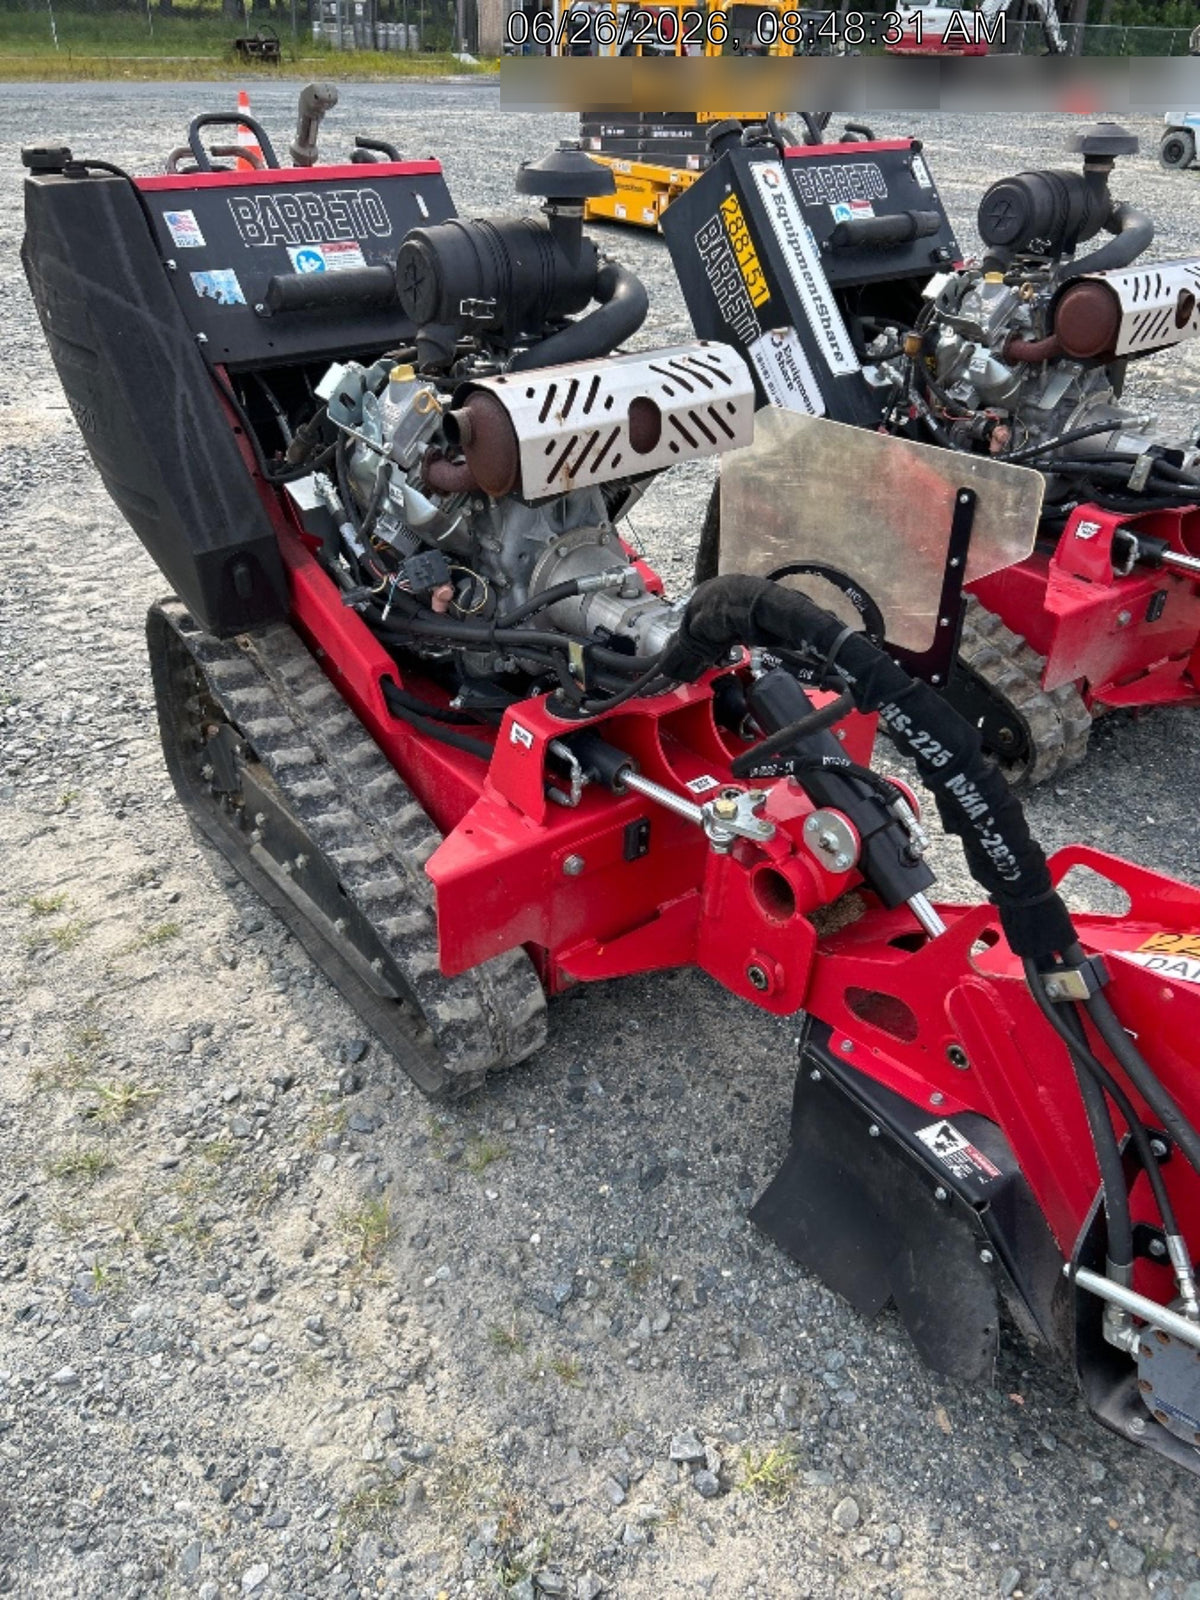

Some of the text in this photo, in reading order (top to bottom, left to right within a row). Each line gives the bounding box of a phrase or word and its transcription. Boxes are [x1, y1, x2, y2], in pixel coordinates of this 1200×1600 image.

[793, 163, 888, 206] BARRETO
[227, 188, 393, 247] BARRETO
[721, 197, 770, 304] 288151
[771, 192, 845, 361] EquipmentShare
[1143, 957, 1200, 979] DA
